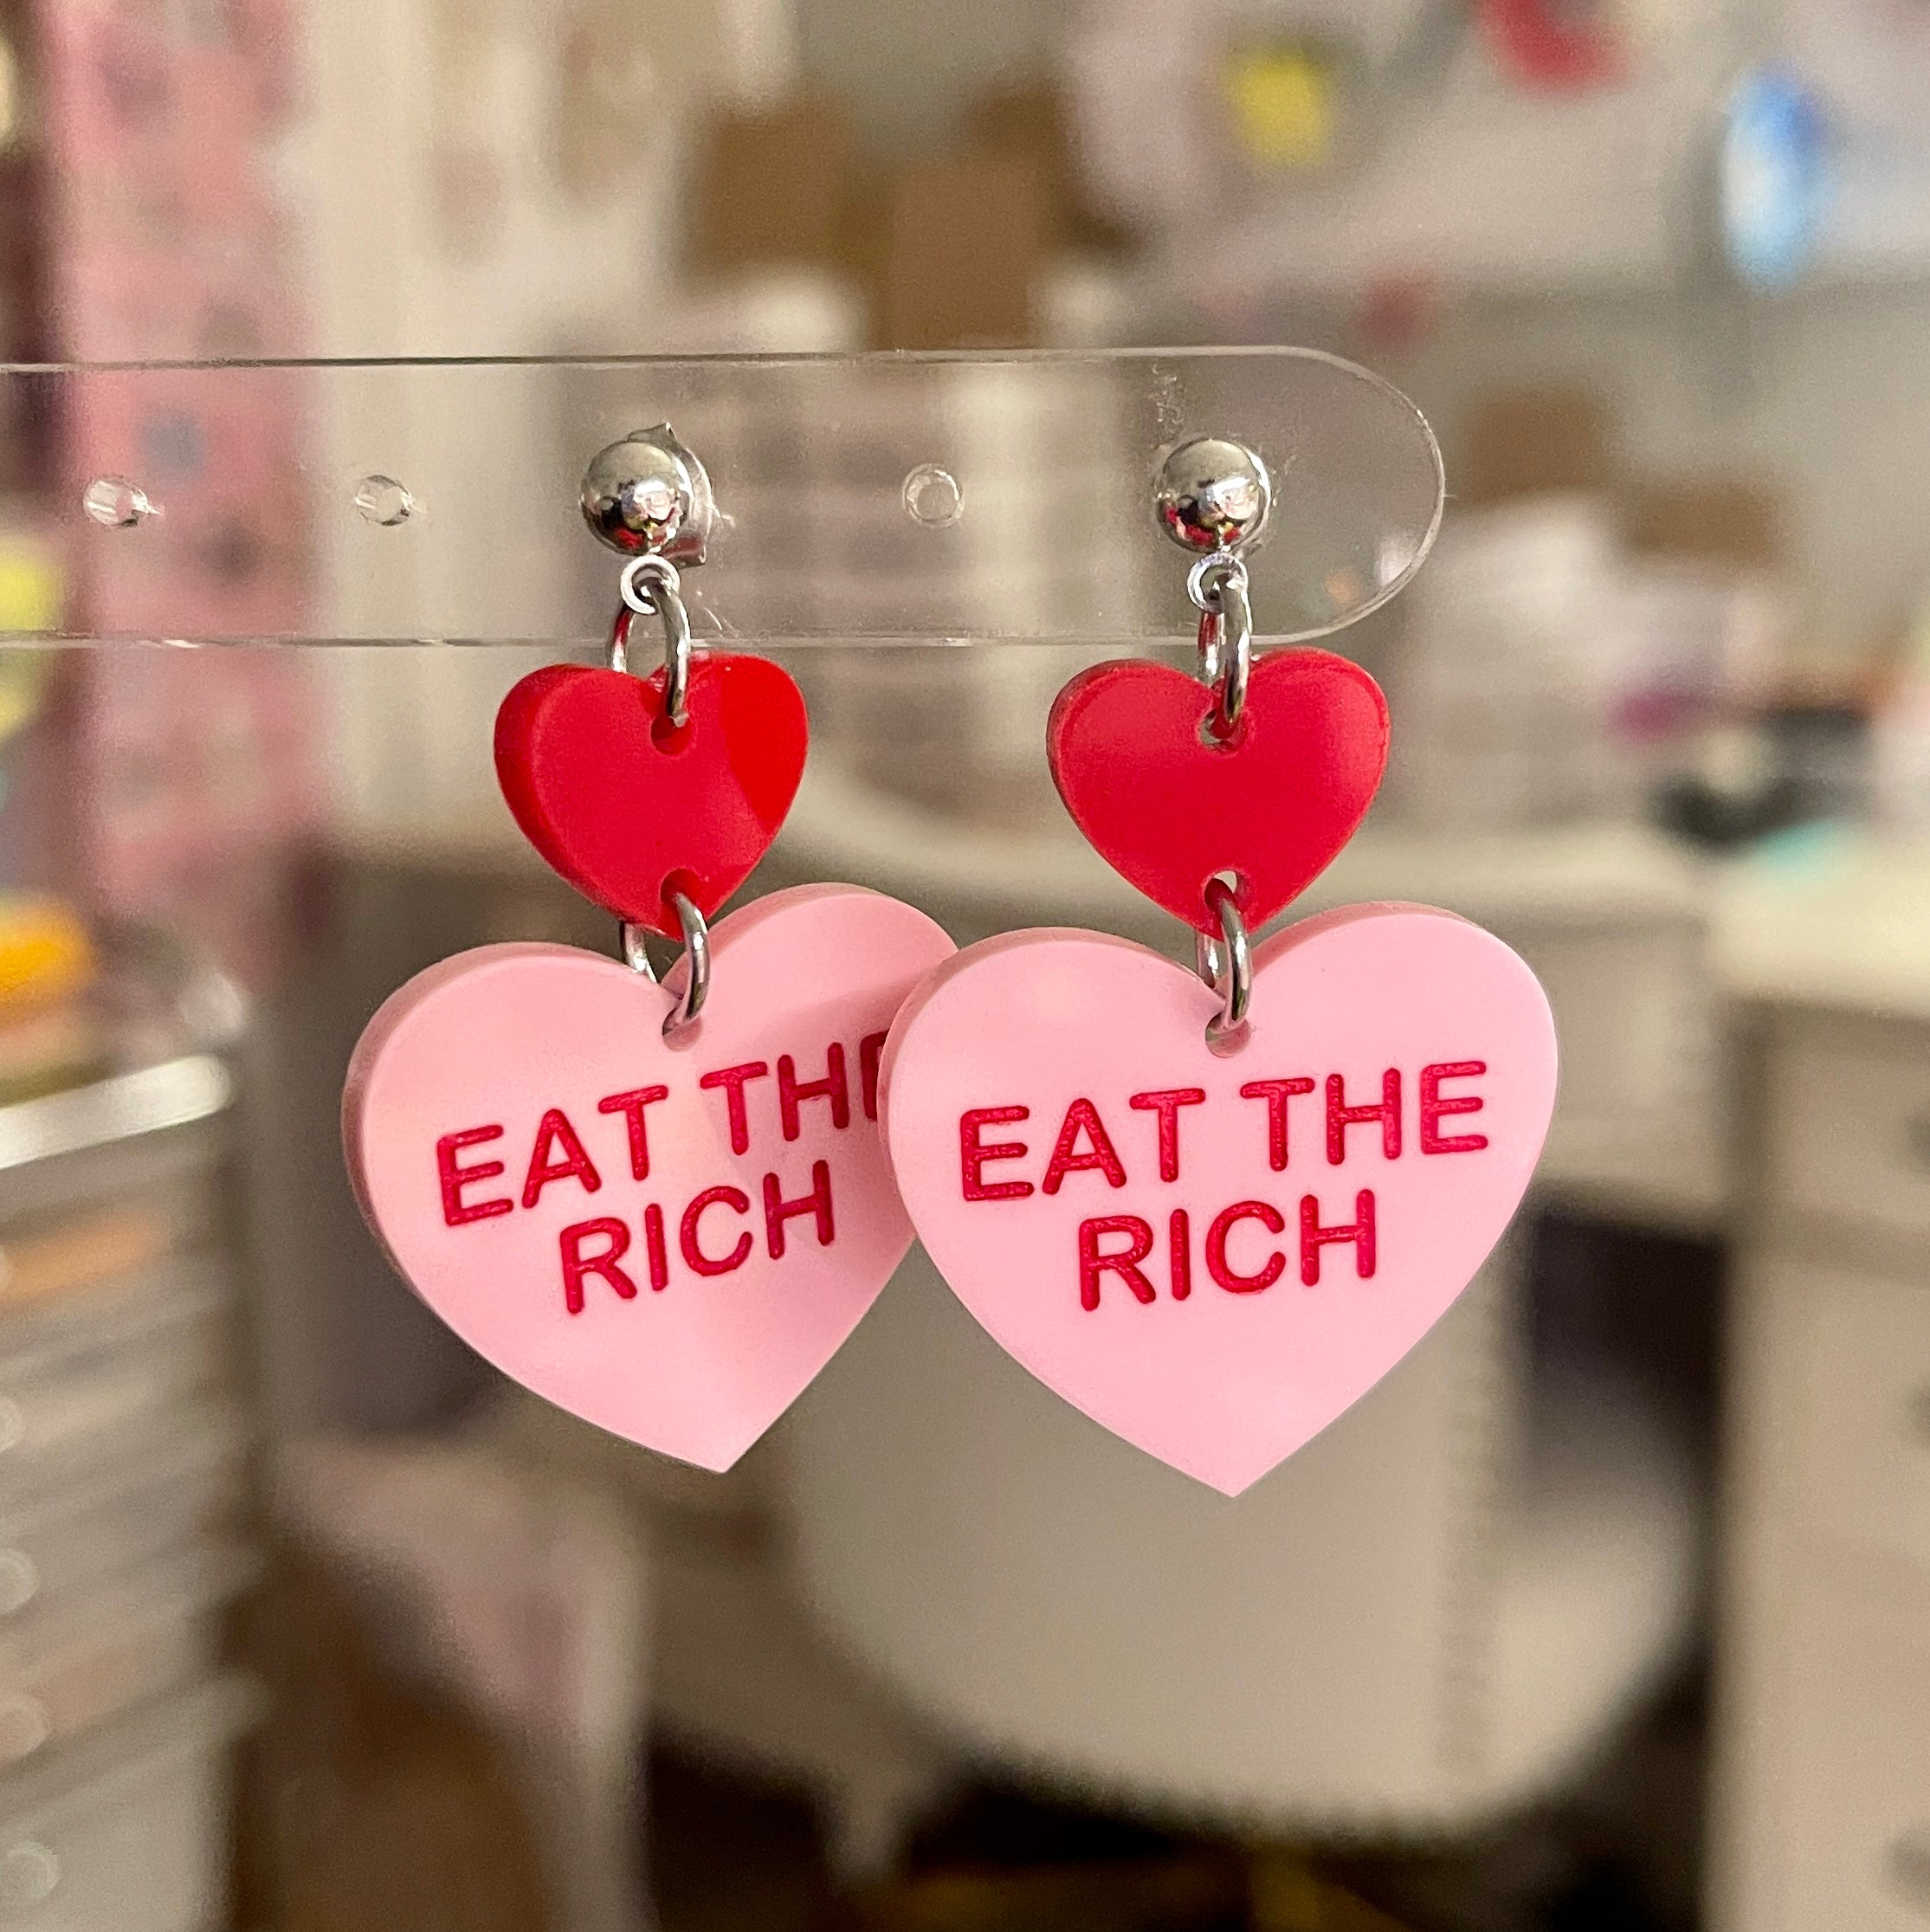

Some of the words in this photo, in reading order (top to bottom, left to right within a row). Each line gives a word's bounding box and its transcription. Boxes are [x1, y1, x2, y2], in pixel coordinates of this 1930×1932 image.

[436, 1084, 668, 1228] EAT
[959, 1088, 1206, 1202] EAT
[1239, 1060, 1488, 1172] THE
[558, 1160, 836, 1316] RICH
[1078, 1188, 1377, 1312] RICH
